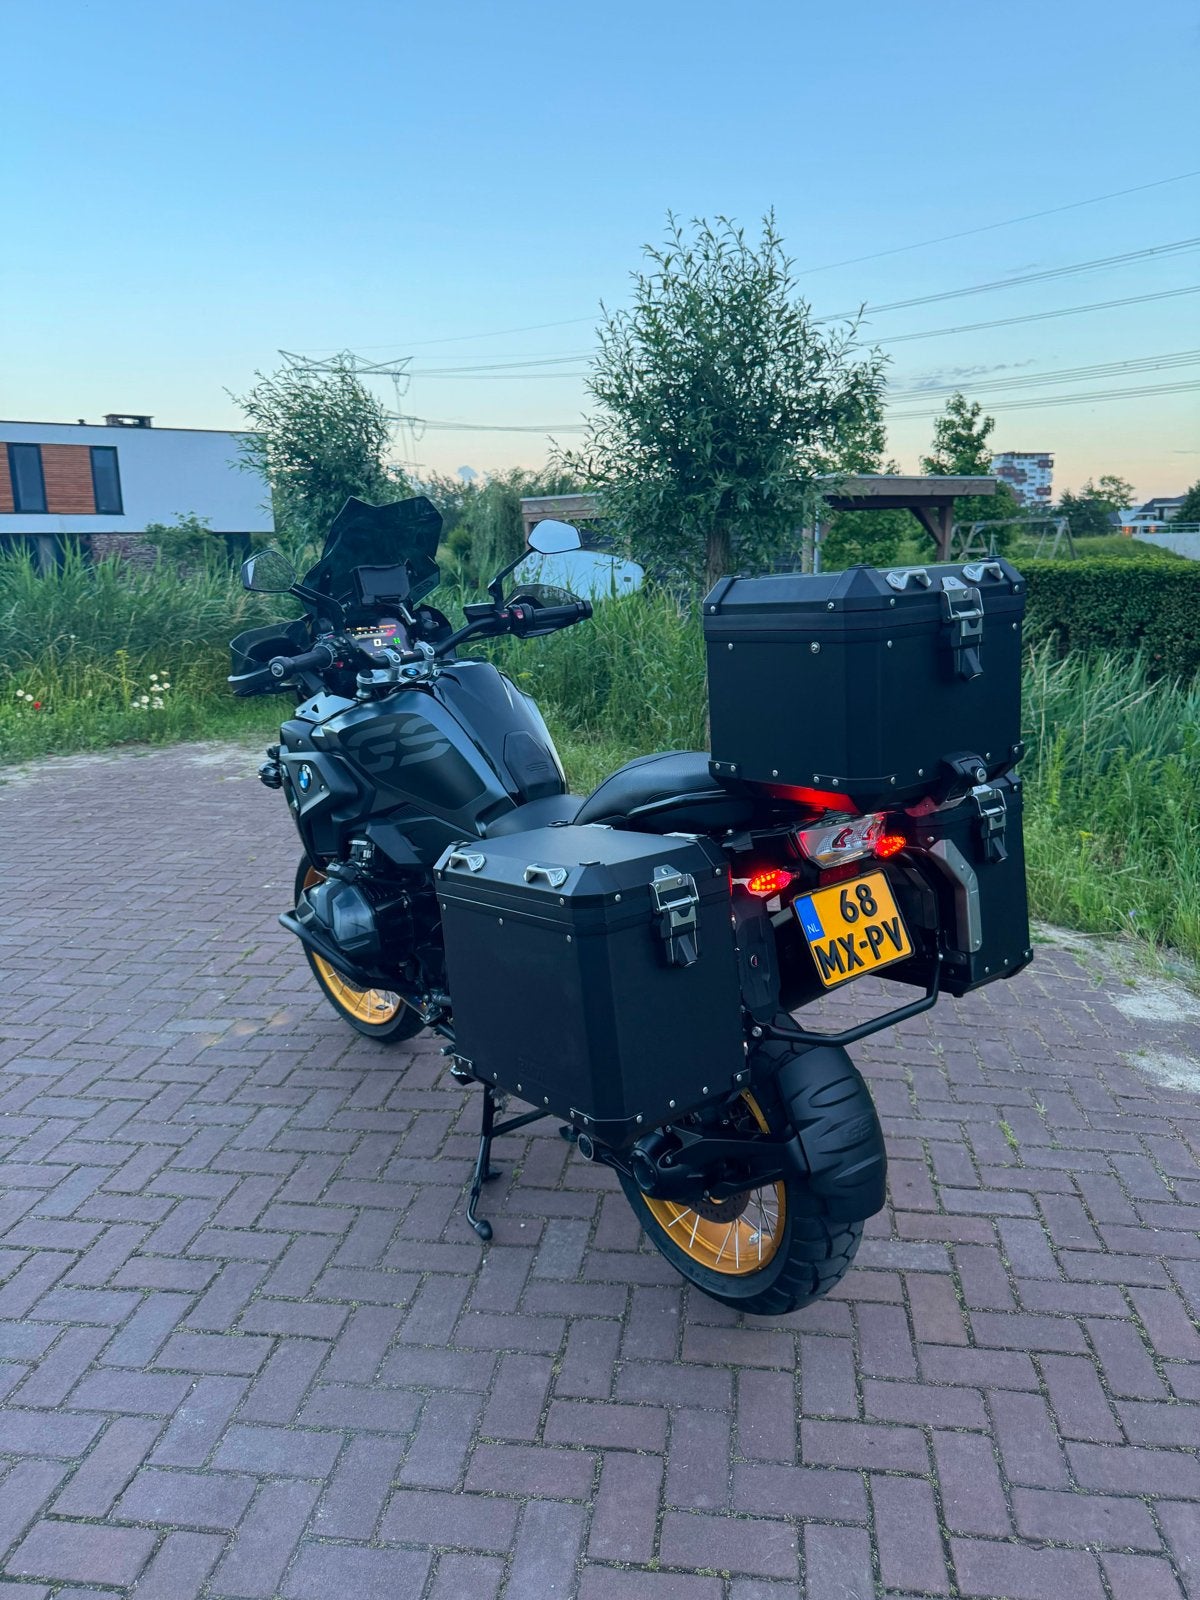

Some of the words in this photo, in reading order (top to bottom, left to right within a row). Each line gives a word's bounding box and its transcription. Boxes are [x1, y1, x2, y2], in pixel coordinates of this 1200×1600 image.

[840, 884, 878, 923] 68
[807, 923, 820, 934] NL
[814, 917, 904, 980] MX-PV
